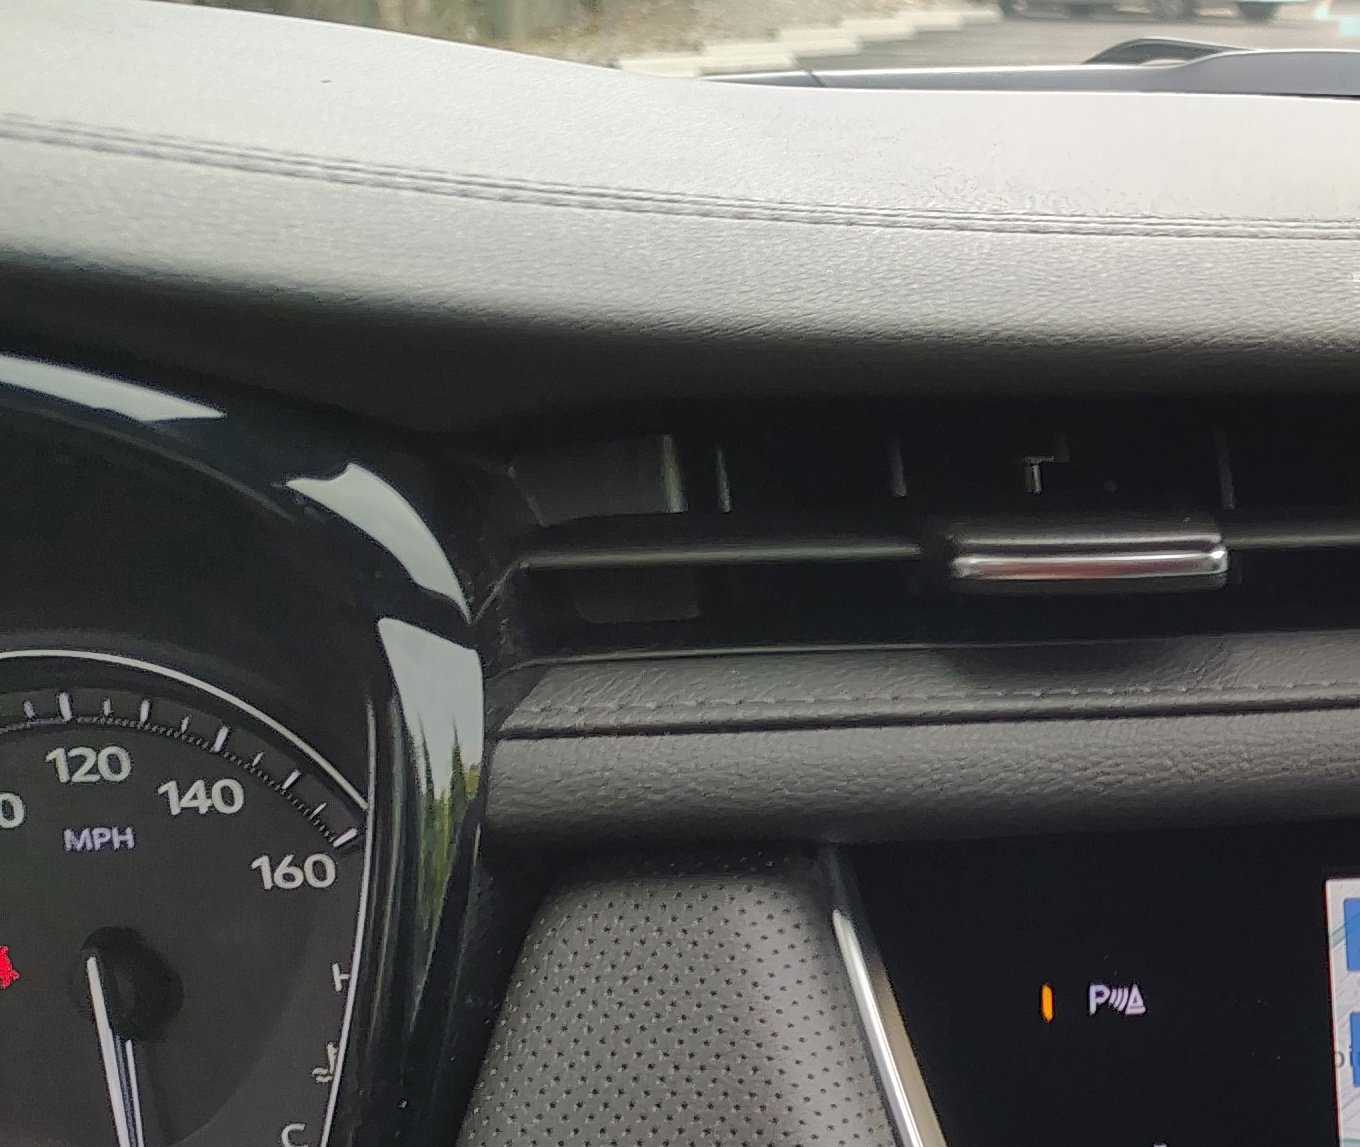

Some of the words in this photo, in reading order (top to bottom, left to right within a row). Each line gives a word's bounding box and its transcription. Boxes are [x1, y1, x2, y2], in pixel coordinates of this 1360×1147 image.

[45, 746, 133, 785] 120
[157, 780, 245, 817] 140
[63, 827, 135, 851] MPH
[250, 853, 337, 890] 160
